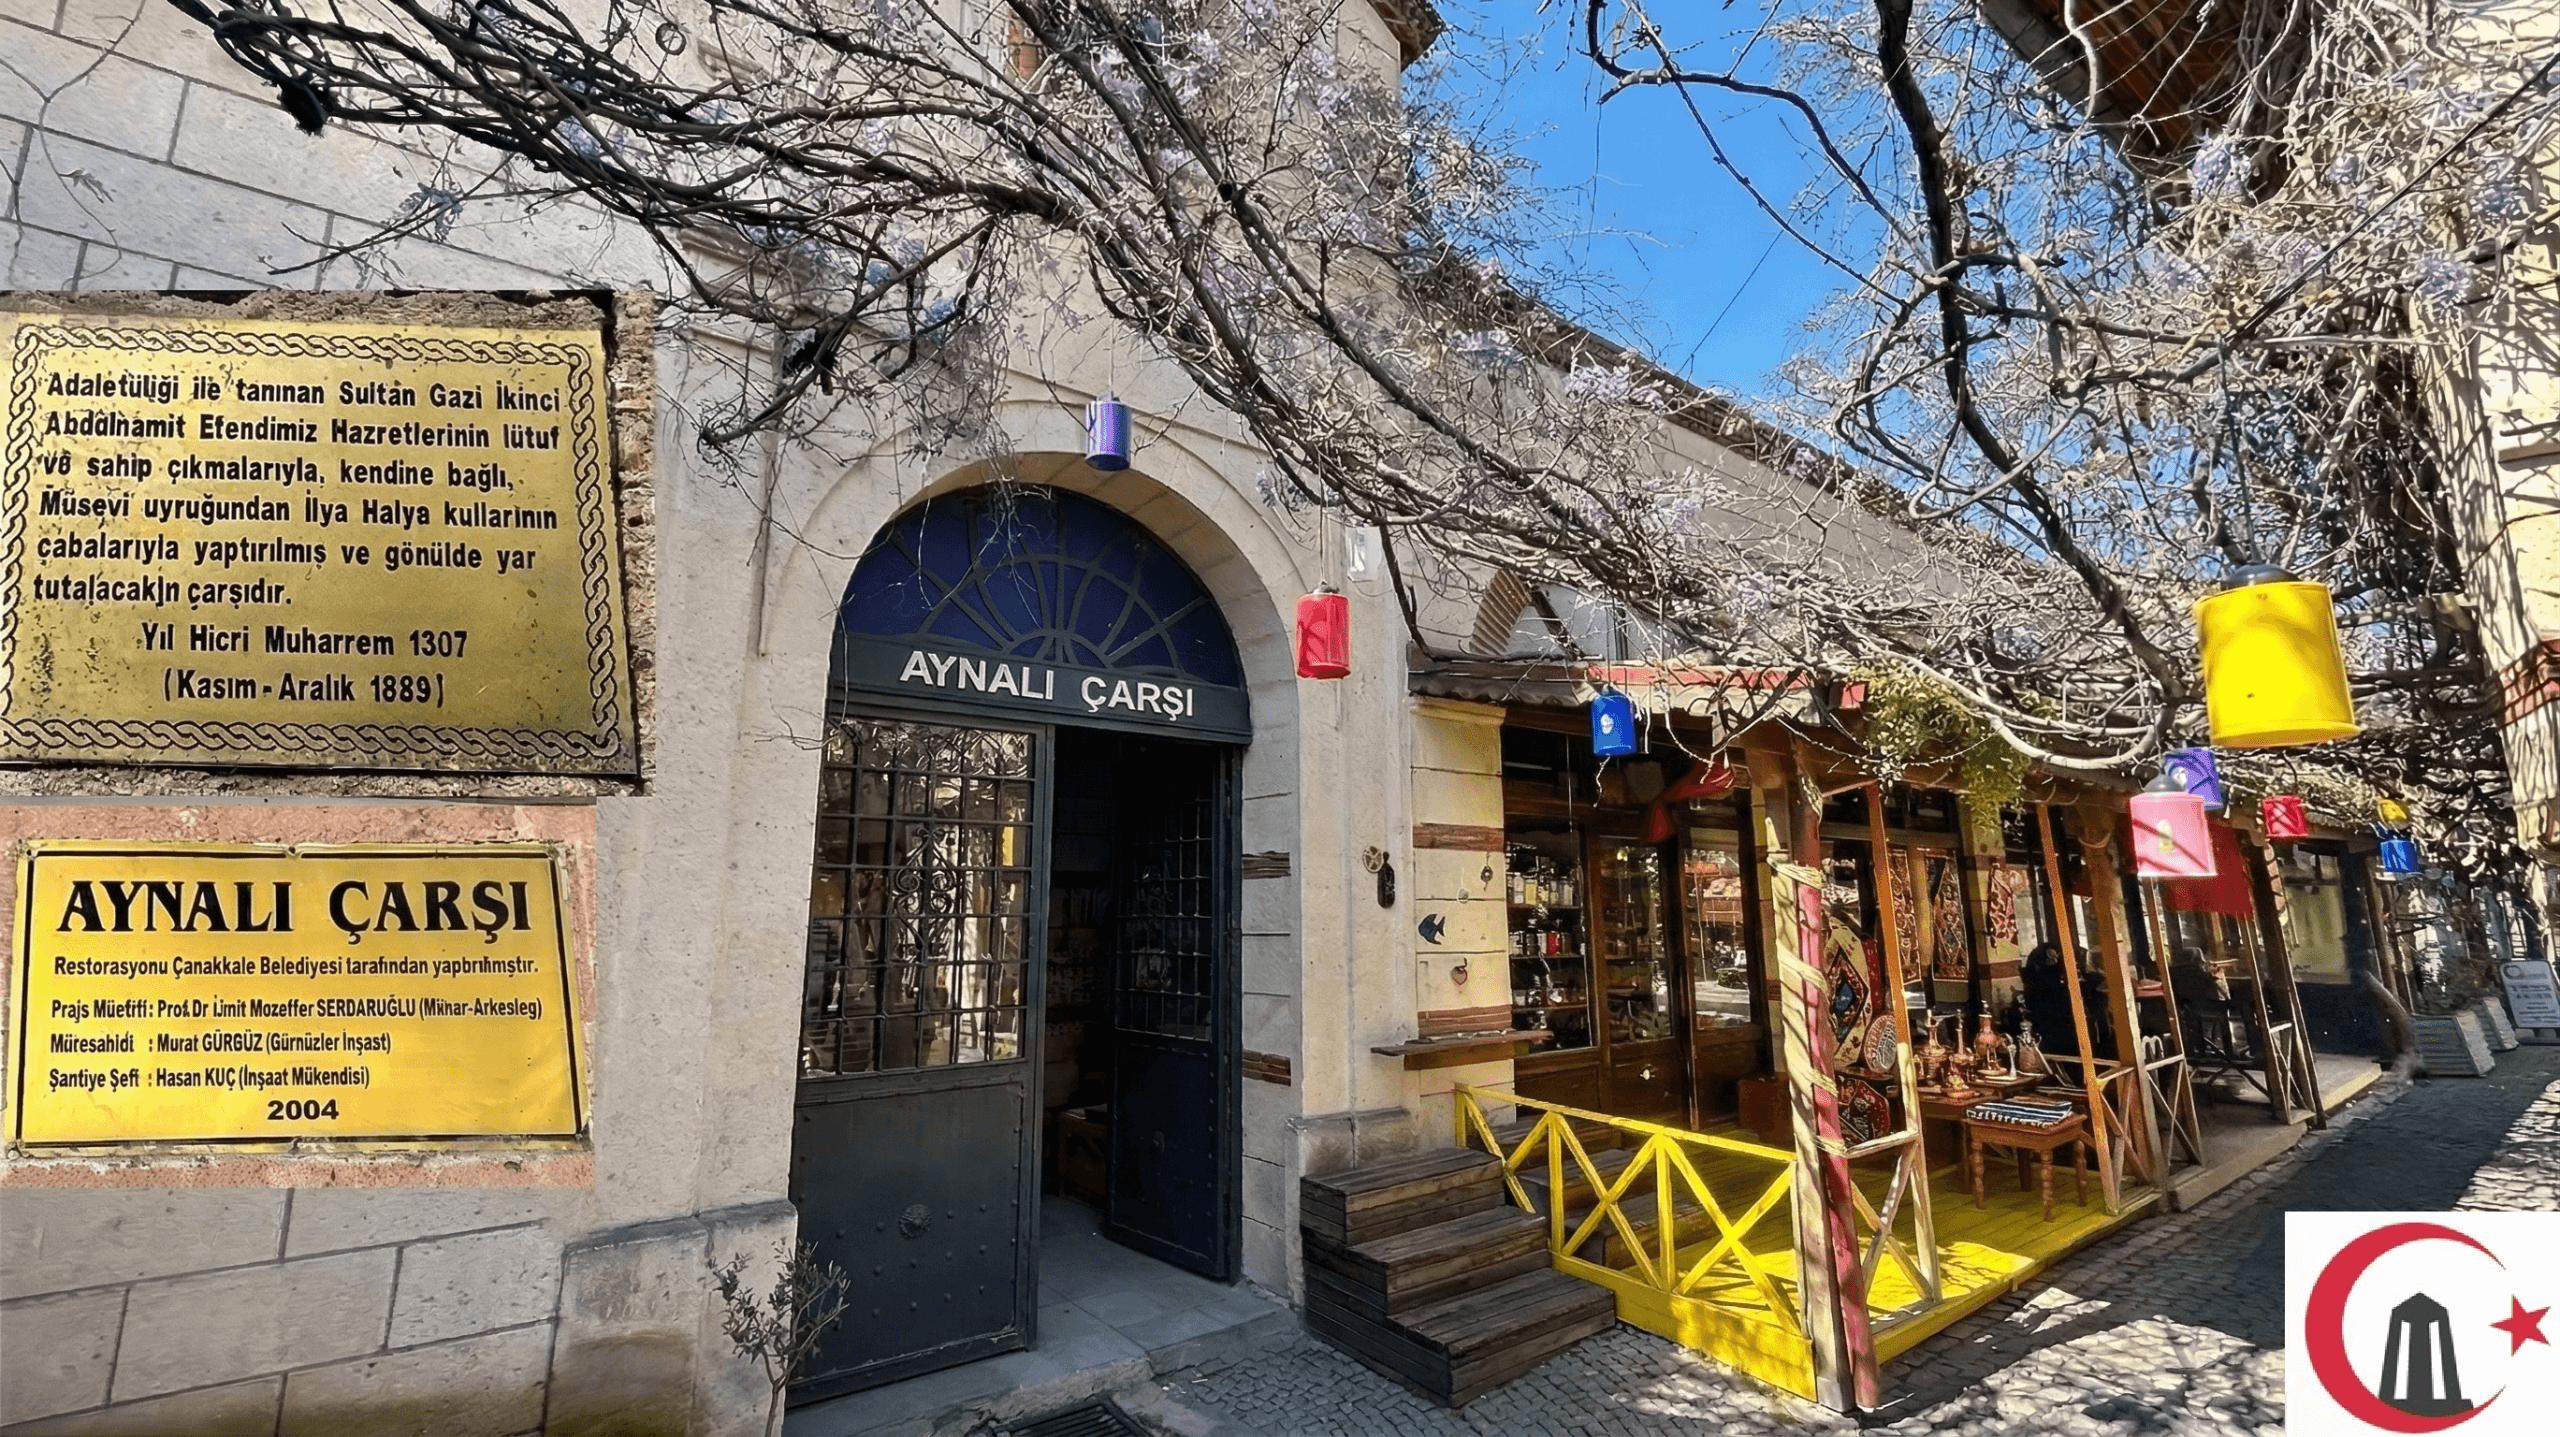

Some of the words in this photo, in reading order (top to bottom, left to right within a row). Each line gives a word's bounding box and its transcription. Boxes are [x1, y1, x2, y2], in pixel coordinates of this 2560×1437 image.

[235, 378, 325, 404] tanınan
[429, 383, 482, 409] Gazi
[496, 380, 560, 412] İkinci
[200, 414, 317, 443] Efendimiz
[331, 418, 489, 447] Hazretlerinin
[503, 424, 560, 449] lütuf
[87, 452, 152, 482] sahip
[340, 458, 434, 486] kendine
[448, 460, 514, 493] bağlı,
[144, 493, 290, 525] uyruğundan
[305, 489, 348, 528] İlya
[362, 499, 430, 530] Halya
[444, 500, 558, 529] kullarının
[194, 534, 327, 570] yaptırılmış
[341, 545, 370, 565] ve
[385, 541, 482, 571] gönülde
[496, 550, 536, 574] yar
[187, 577, 292, 610] çarşıdır.
[142, 622, 174, 650] Yıl
[190, 624, 249, 652] Hicri
[265, 625, 394, 655] Muharrem
[409, 630, 468, 657] 1307
[278, 673, 356, 701] Aralık
[899, 650, 1055, 700] AYNALI
[1081, 676, 1193, 721] ÇARŞI
[56, 880, 295, 932] AYNALI
[329, 880, 532, 945] ÇARŞI
[54, 956, 168, 980] Restorasyonu
[173, 956, 256, 980] Çanakkale
[260, 956, 343, 980] Belediyesi
[347, 956, 429, 975] tarafından
[317, 993, 416, 1017] SERDARUĞLU
[157, 1033, 199, 1052] Murat
[202, 1029, 263, 1052] GÜRGÜZ
[49, 1068, 106, 1093] Şantiye
[156, 1067, 201, 1087] Hasan
[205, 1067, 236, 1091] KUÇ
[267, 1099, 339, 1120] 2004
